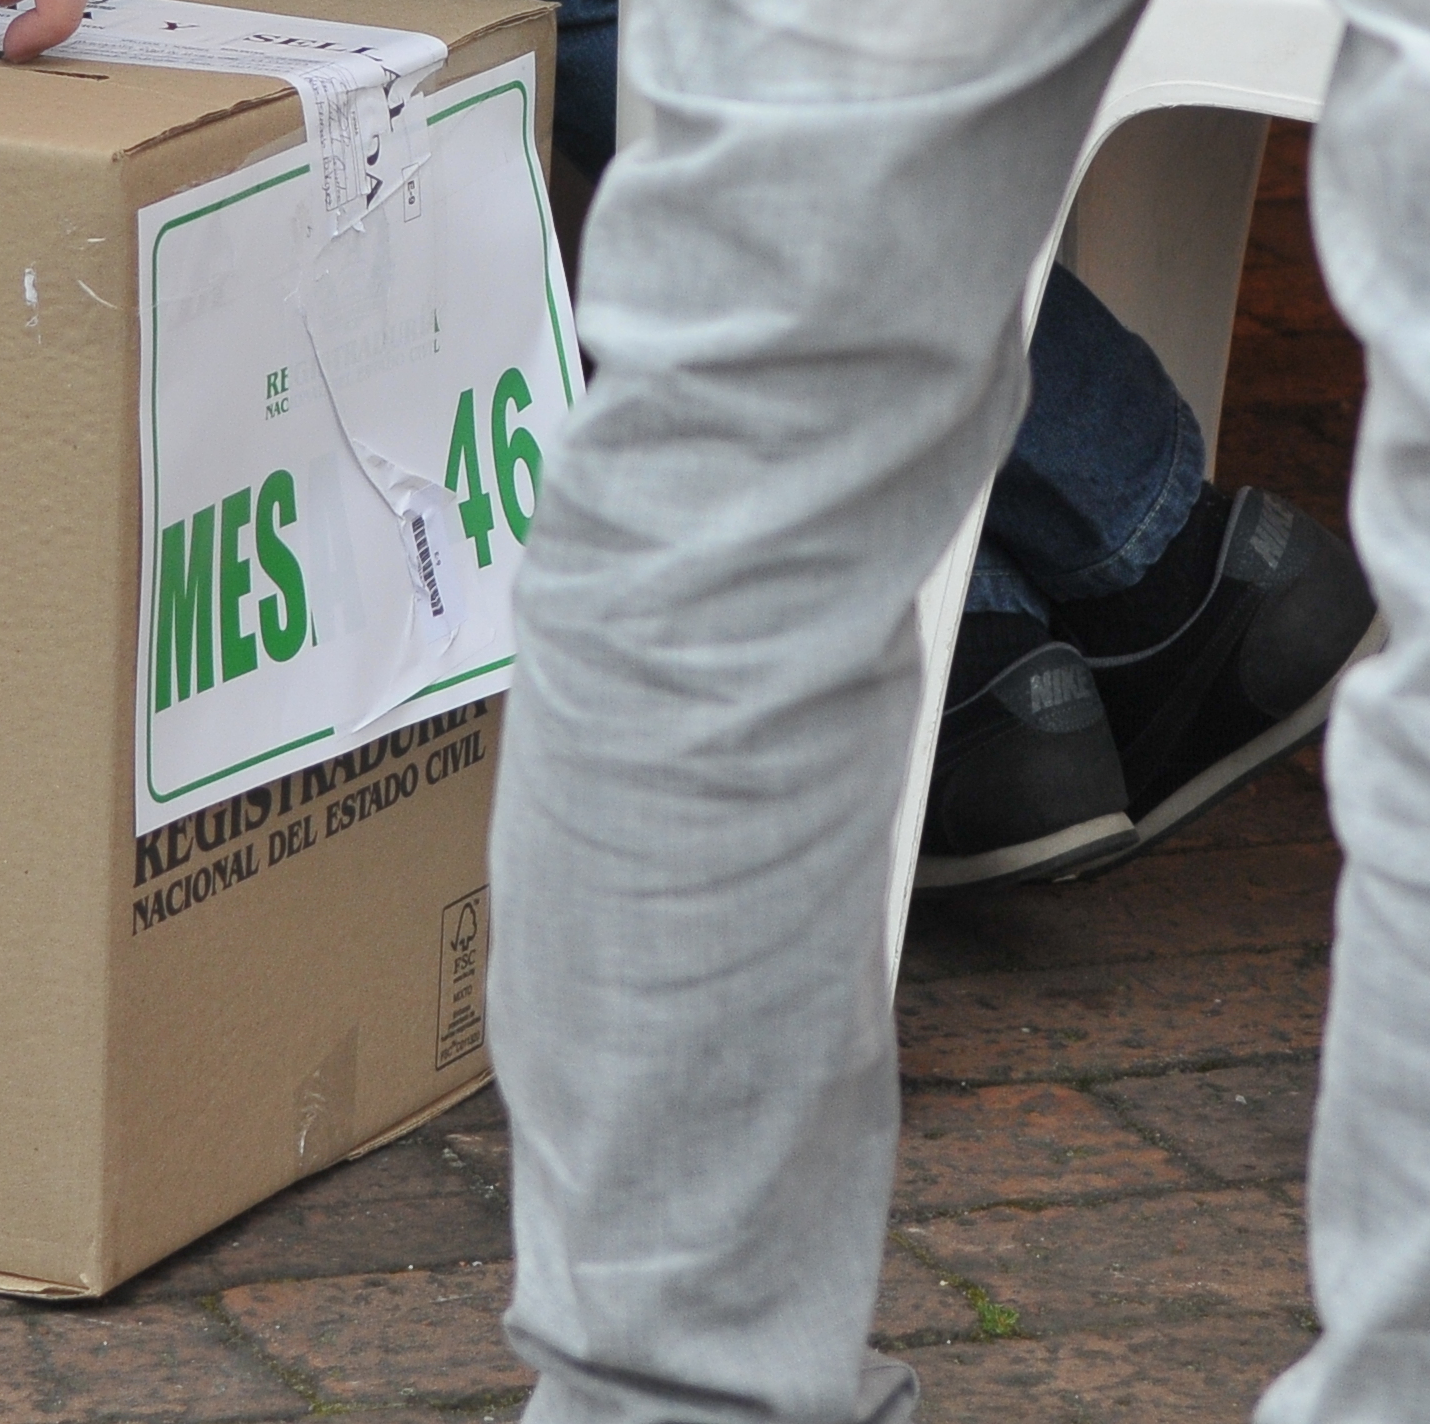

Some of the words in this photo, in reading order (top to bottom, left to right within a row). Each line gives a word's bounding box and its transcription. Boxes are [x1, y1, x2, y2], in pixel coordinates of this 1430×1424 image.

[156, 467, 319, 714] MES
[444, 367, 543, 569] 46
[131, 842, 260, 937] NACIONAL
[268, 814, 319, 868] DEL
[325, 762, 419, 839] ESTADO
[425, 729, 487, 786] CIVIL
[453, 948, 477, 975] FSC
